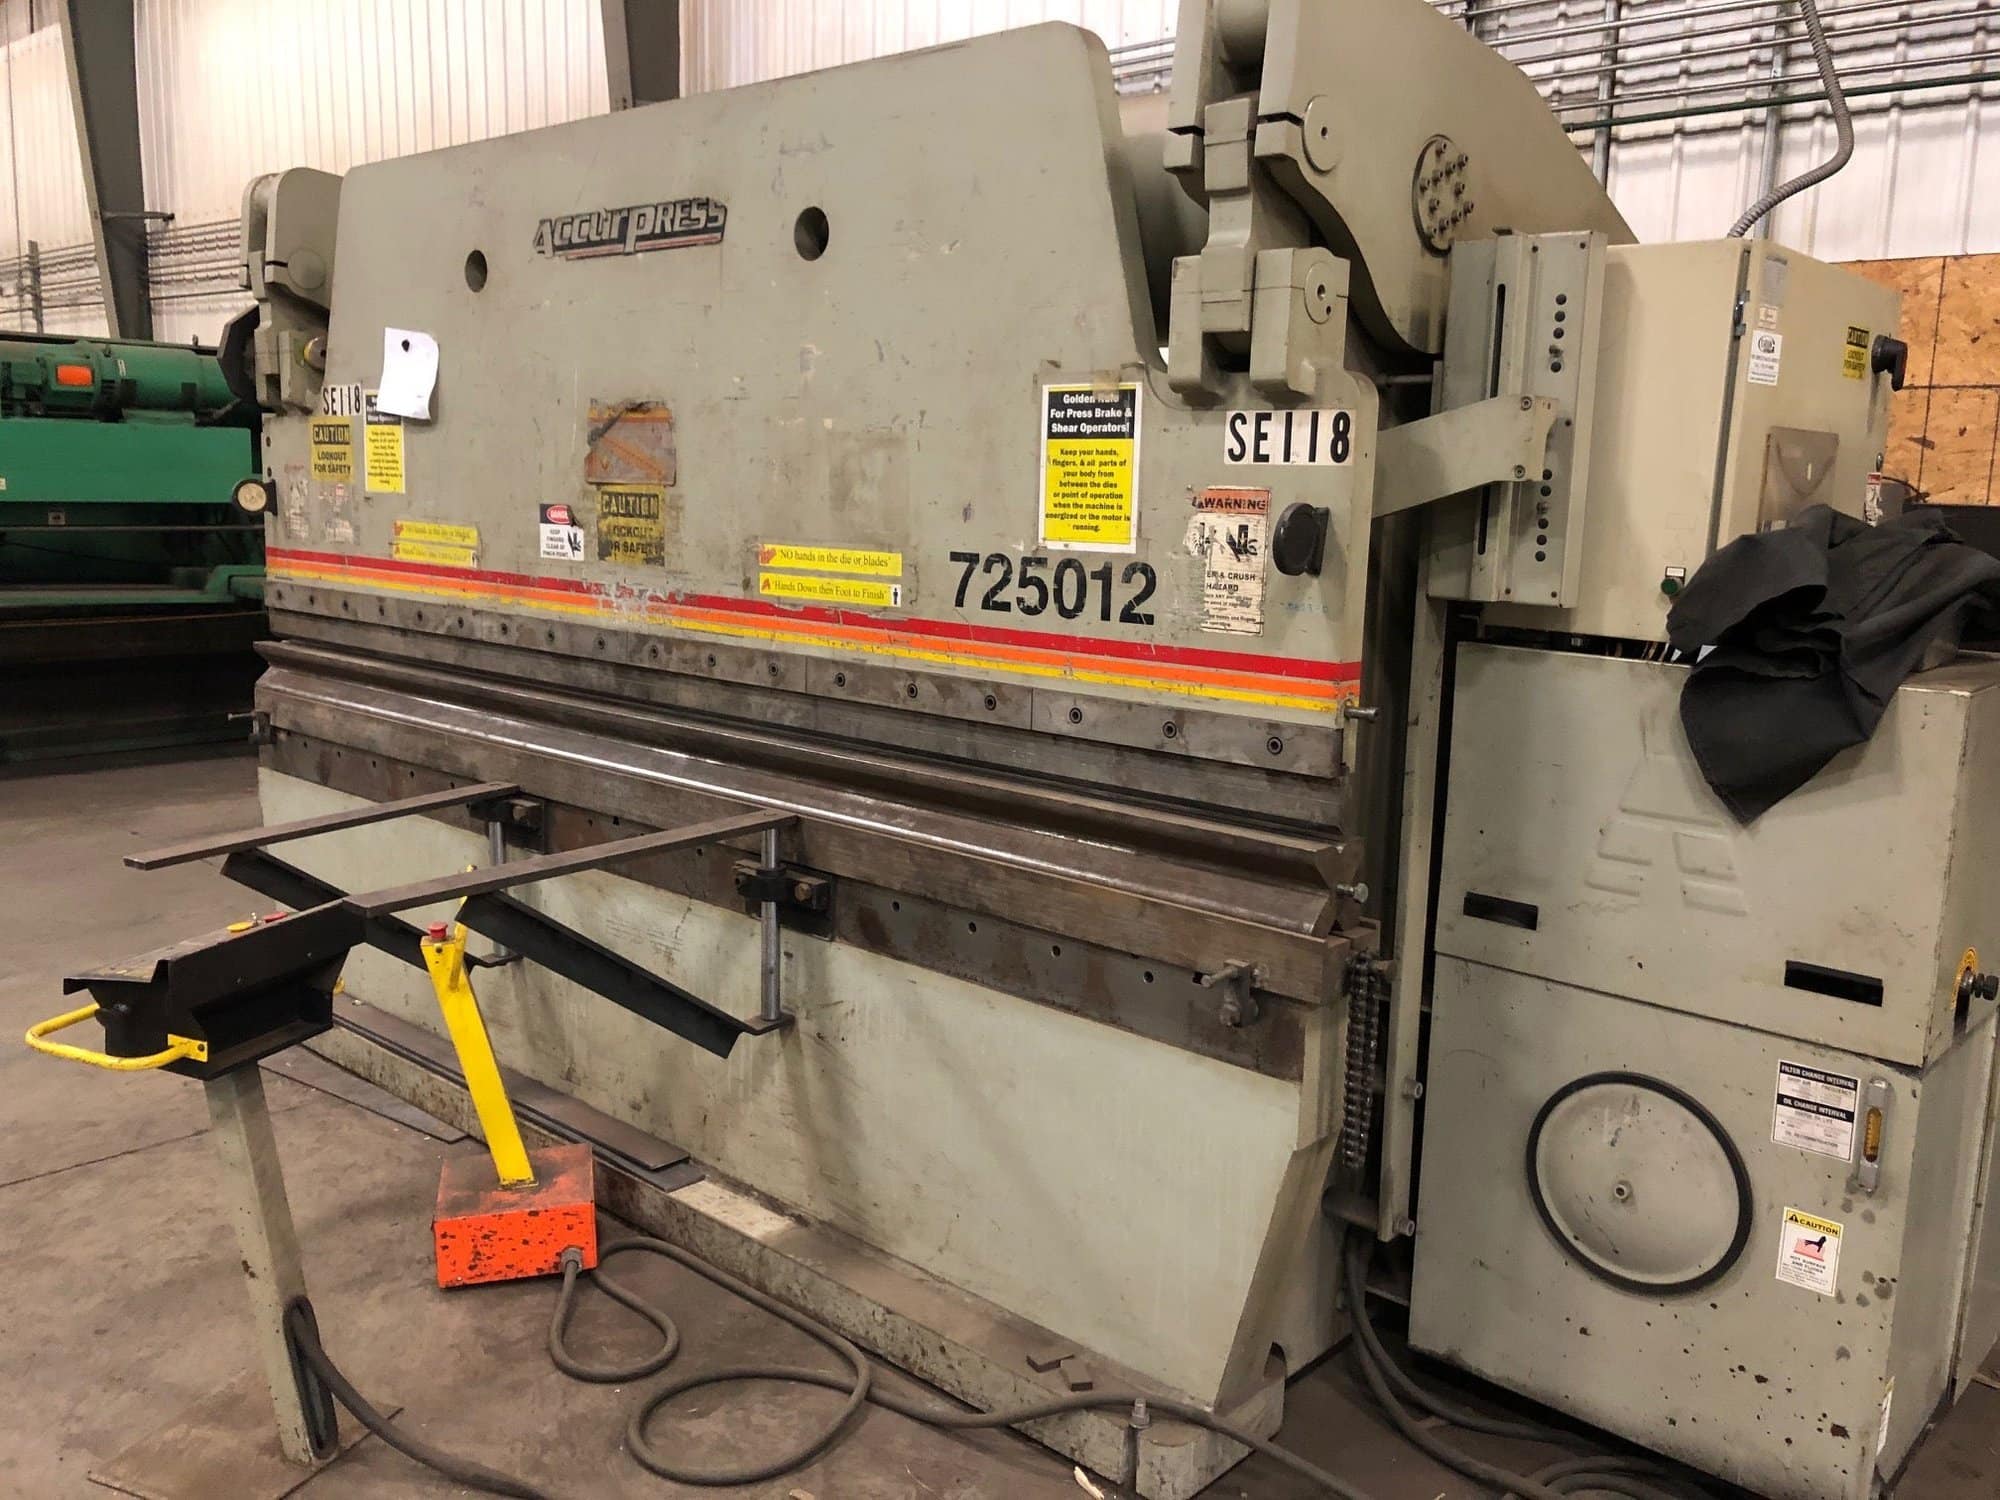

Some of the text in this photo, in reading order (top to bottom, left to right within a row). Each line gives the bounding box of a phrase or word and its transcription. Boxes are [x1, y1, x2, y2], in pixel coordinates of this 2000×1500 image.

[322, 385, 361, 416] SE118
[1063, 393, 1095, 404] Golden
[1050, 407, 1133, 418] For Press Brake &
[1051, 422, 1130, 434] Shear Operators!
[313, 426, 350, 442] CAUTION
[1227, 411, 1351, 463] SE118
[1060, 448, 1077, 457] Keep
[1079, 449, 1094, 457] your
[314, 464, 327, 473] FOR
[327, 464, 351, 474] SAFETY
[1098, 460, 1117, 468] parts
[1118, 459, 1127, 467] of
[1079, 470, 1096, 478] body
[1059, 480, 1088, 488] between
[1061, 491, 1079, 499] point
[602, 495, 658, 515] CAUTION
[1085, 502, 1115, 510] machine
[1204, 497, 1266, 510] WARNING
[1045, 512, 1078, 520] energized
[794, 550, 816, 561] hands
[817, 553, 825, 562] in
[826, 552, 838, 563] the
[839, 552, 852, 564] die
[853, 556, 862, 566] or
[1227, 572, 1256, 581] CRUSH
[797, 582, 819, 593] Down
[835, 586, 851, 598] Foot
[853, 588, 861, 598] to
[950, 551, 1157, 625] 725012
[1206, 583, 1239, 592] HAZARD
[1781, 1064, 1855, 1088] FILTER CHANGE INTERVAL
[1783, 1097, 1793, 1106] OIL
[1793, 1100, 1817, 1111] CHANGE
[1818, 1105, 1847, 1119] INTERVAL
[1800, 1219, 1838, 1235] CAUTION
